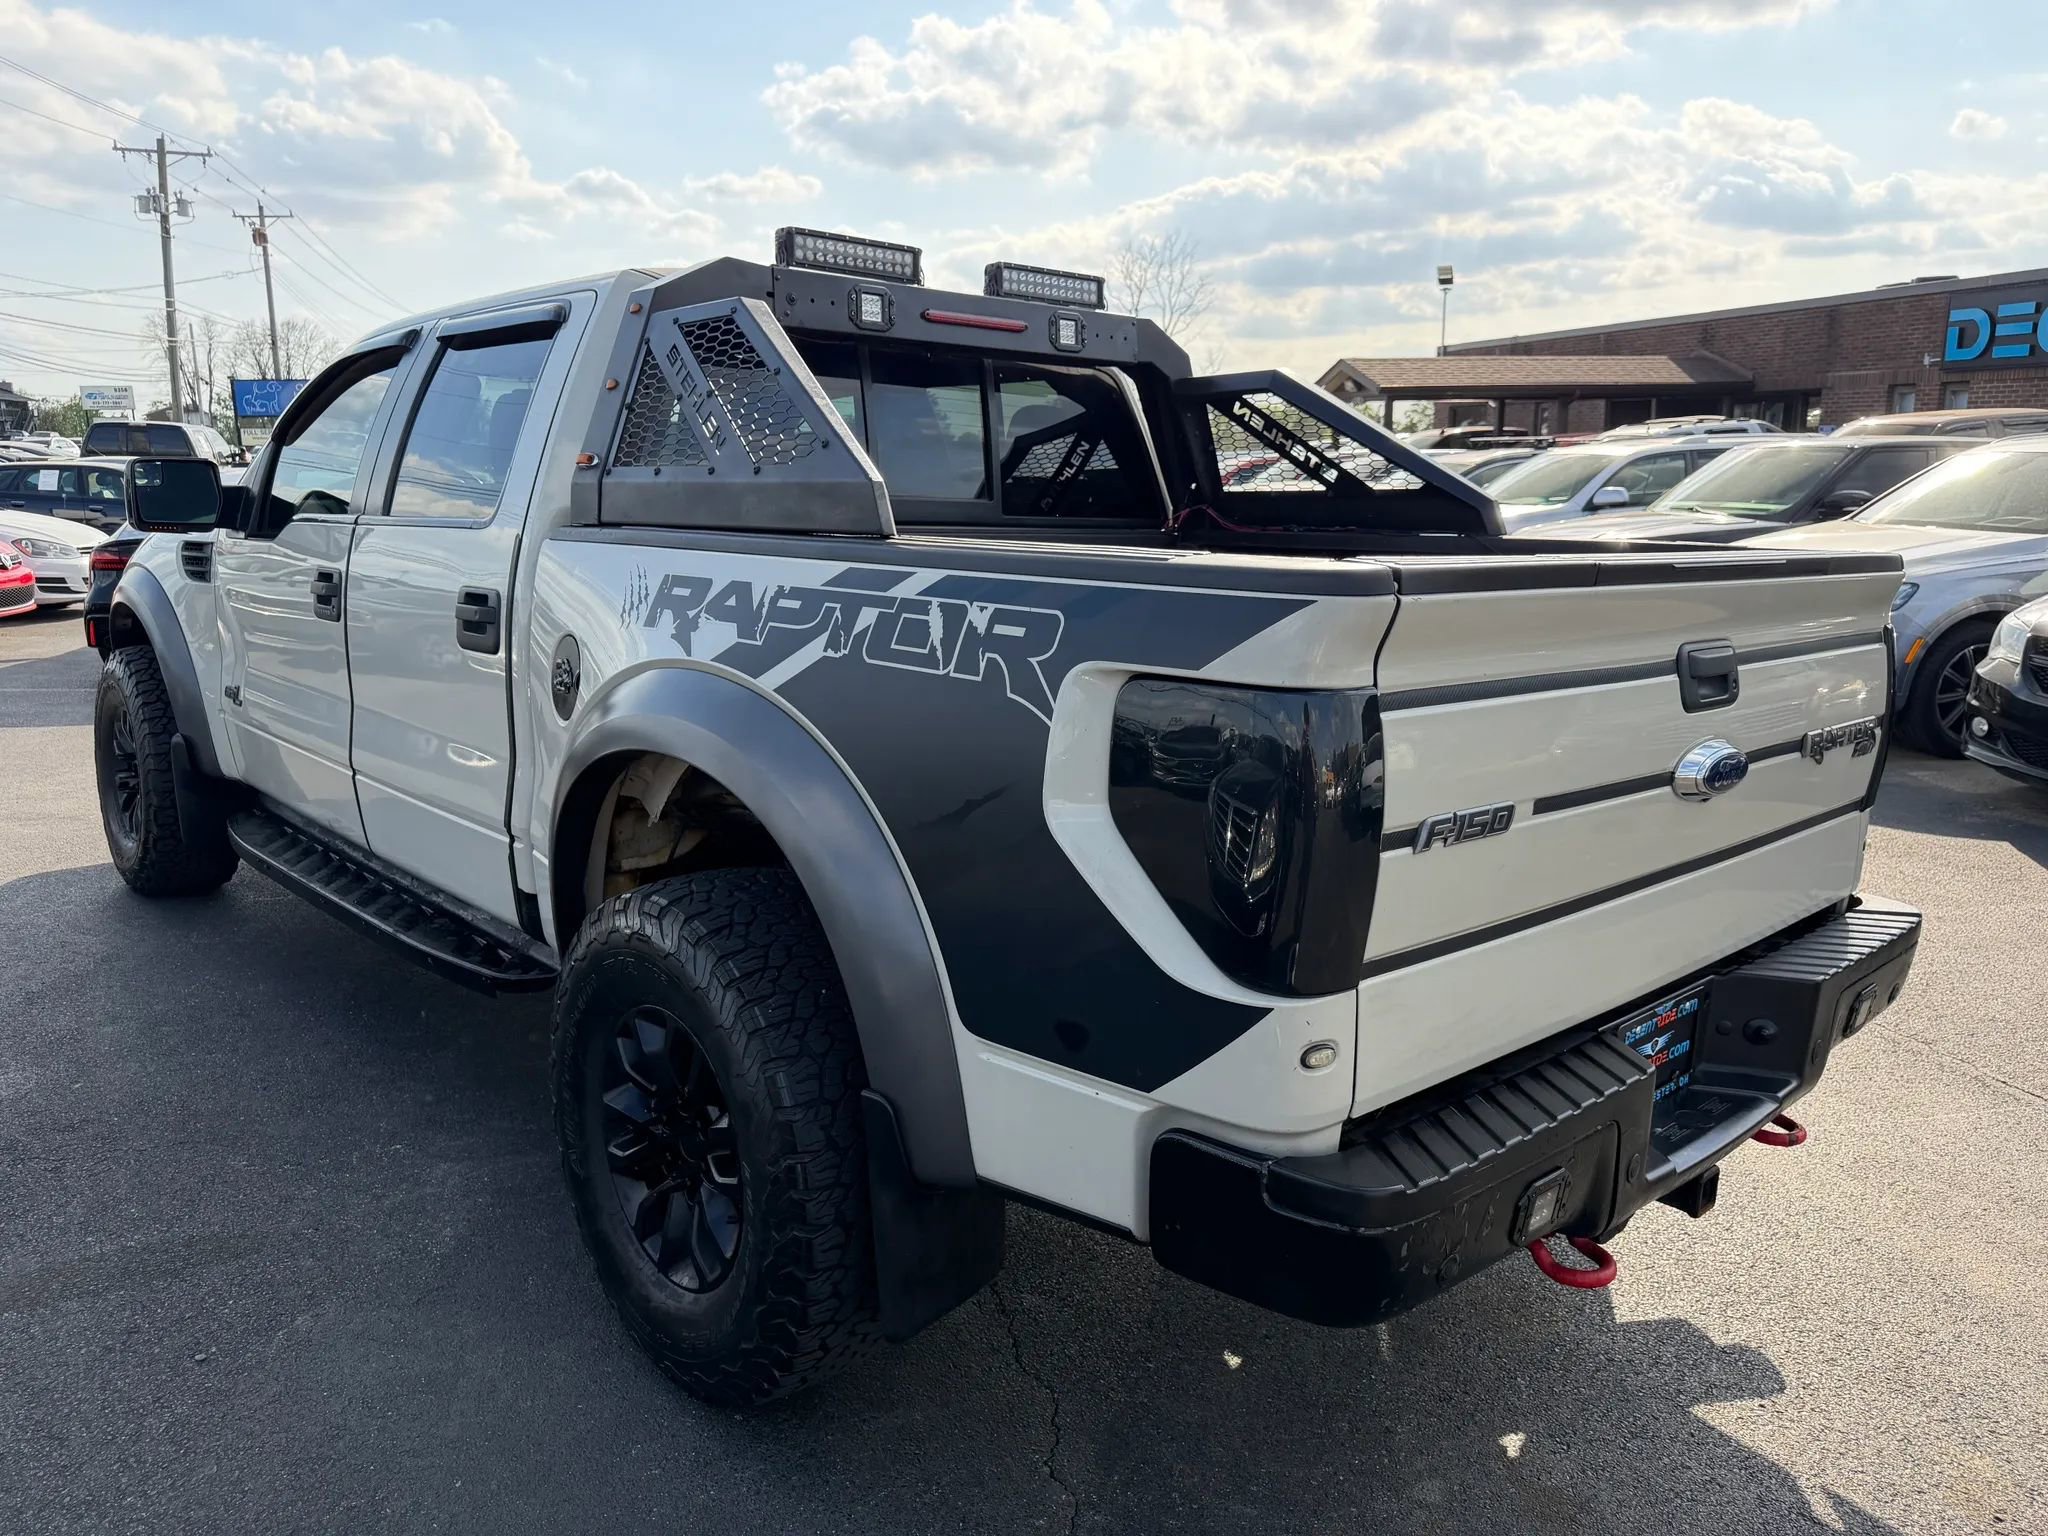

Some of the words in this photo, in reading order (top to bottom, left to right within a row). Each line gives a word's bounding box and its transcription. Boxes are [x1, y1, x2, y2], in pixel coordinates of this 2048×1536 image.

[1945, 301, 2048, 361] DE
[667, 343, 727, 456] STEHLEN
[640, 572, 1065, 726] RAPTOR
[1711, 755, 1747, 790] Ford
[1413, 800, 1515, 854] F-150
